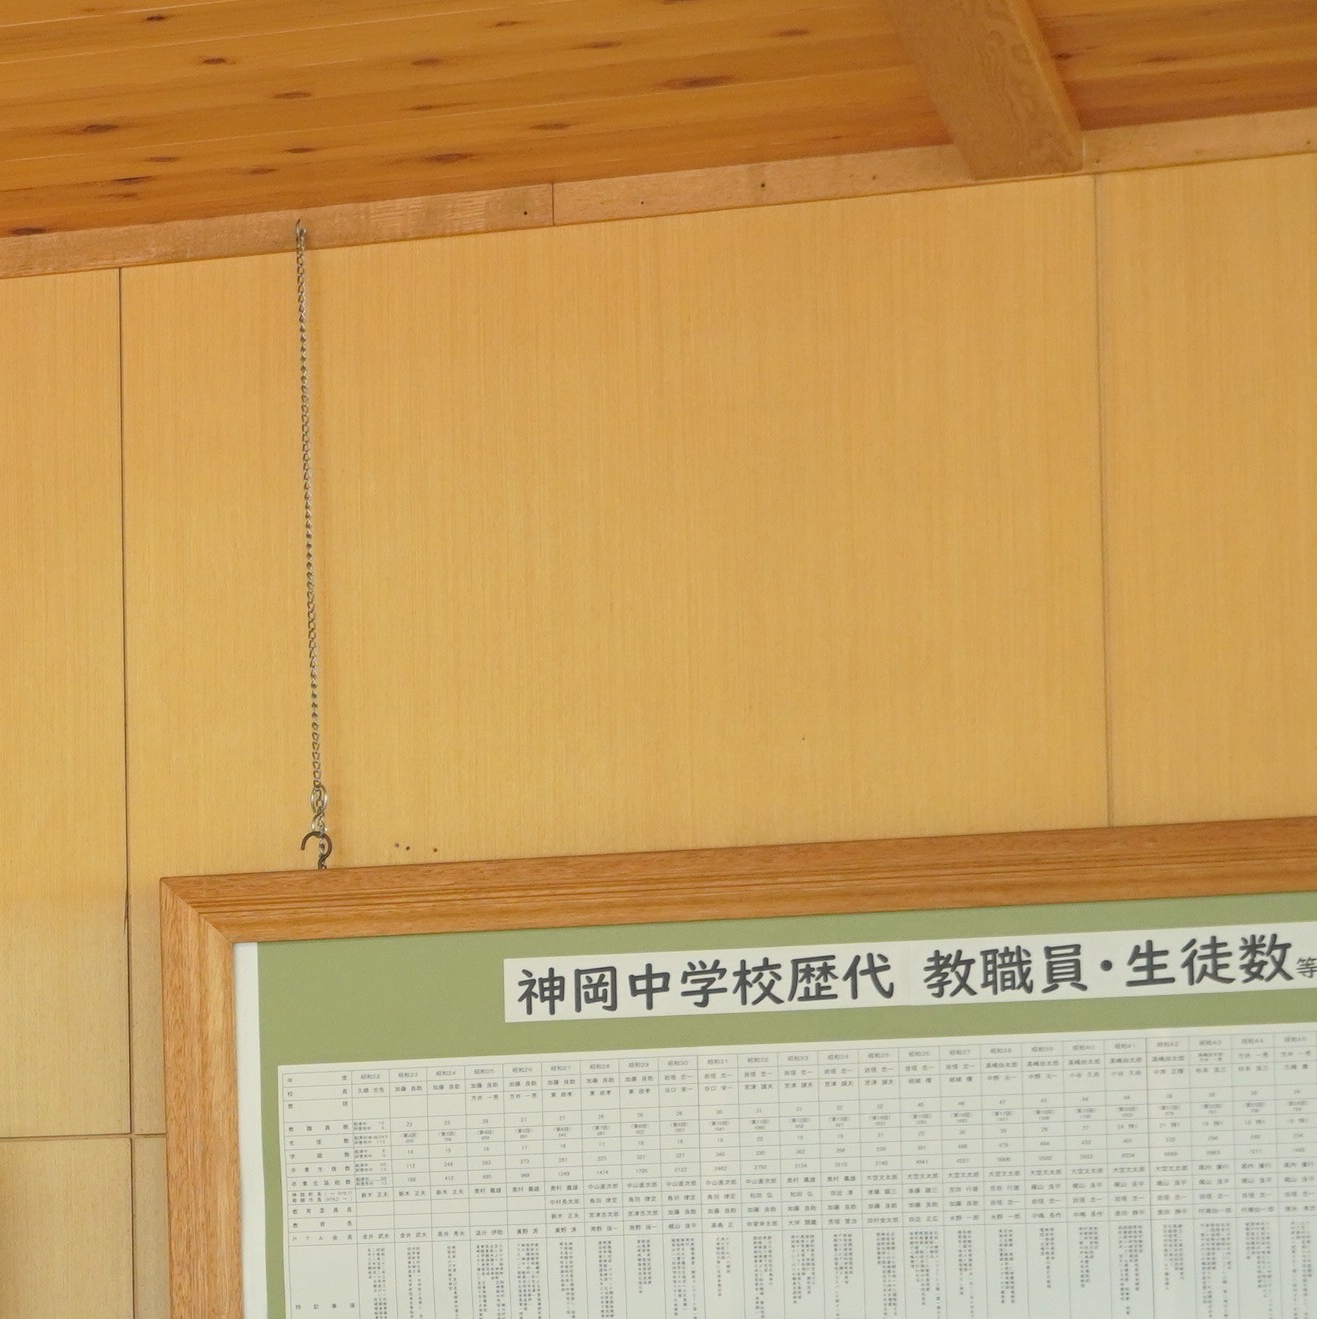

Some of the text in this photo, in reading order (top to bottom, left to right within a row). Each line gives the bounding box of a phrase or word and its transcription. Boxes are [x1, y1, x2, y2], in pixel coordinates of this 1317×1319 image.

[517, 952, 895, 1015] 神岡中学校歴代
